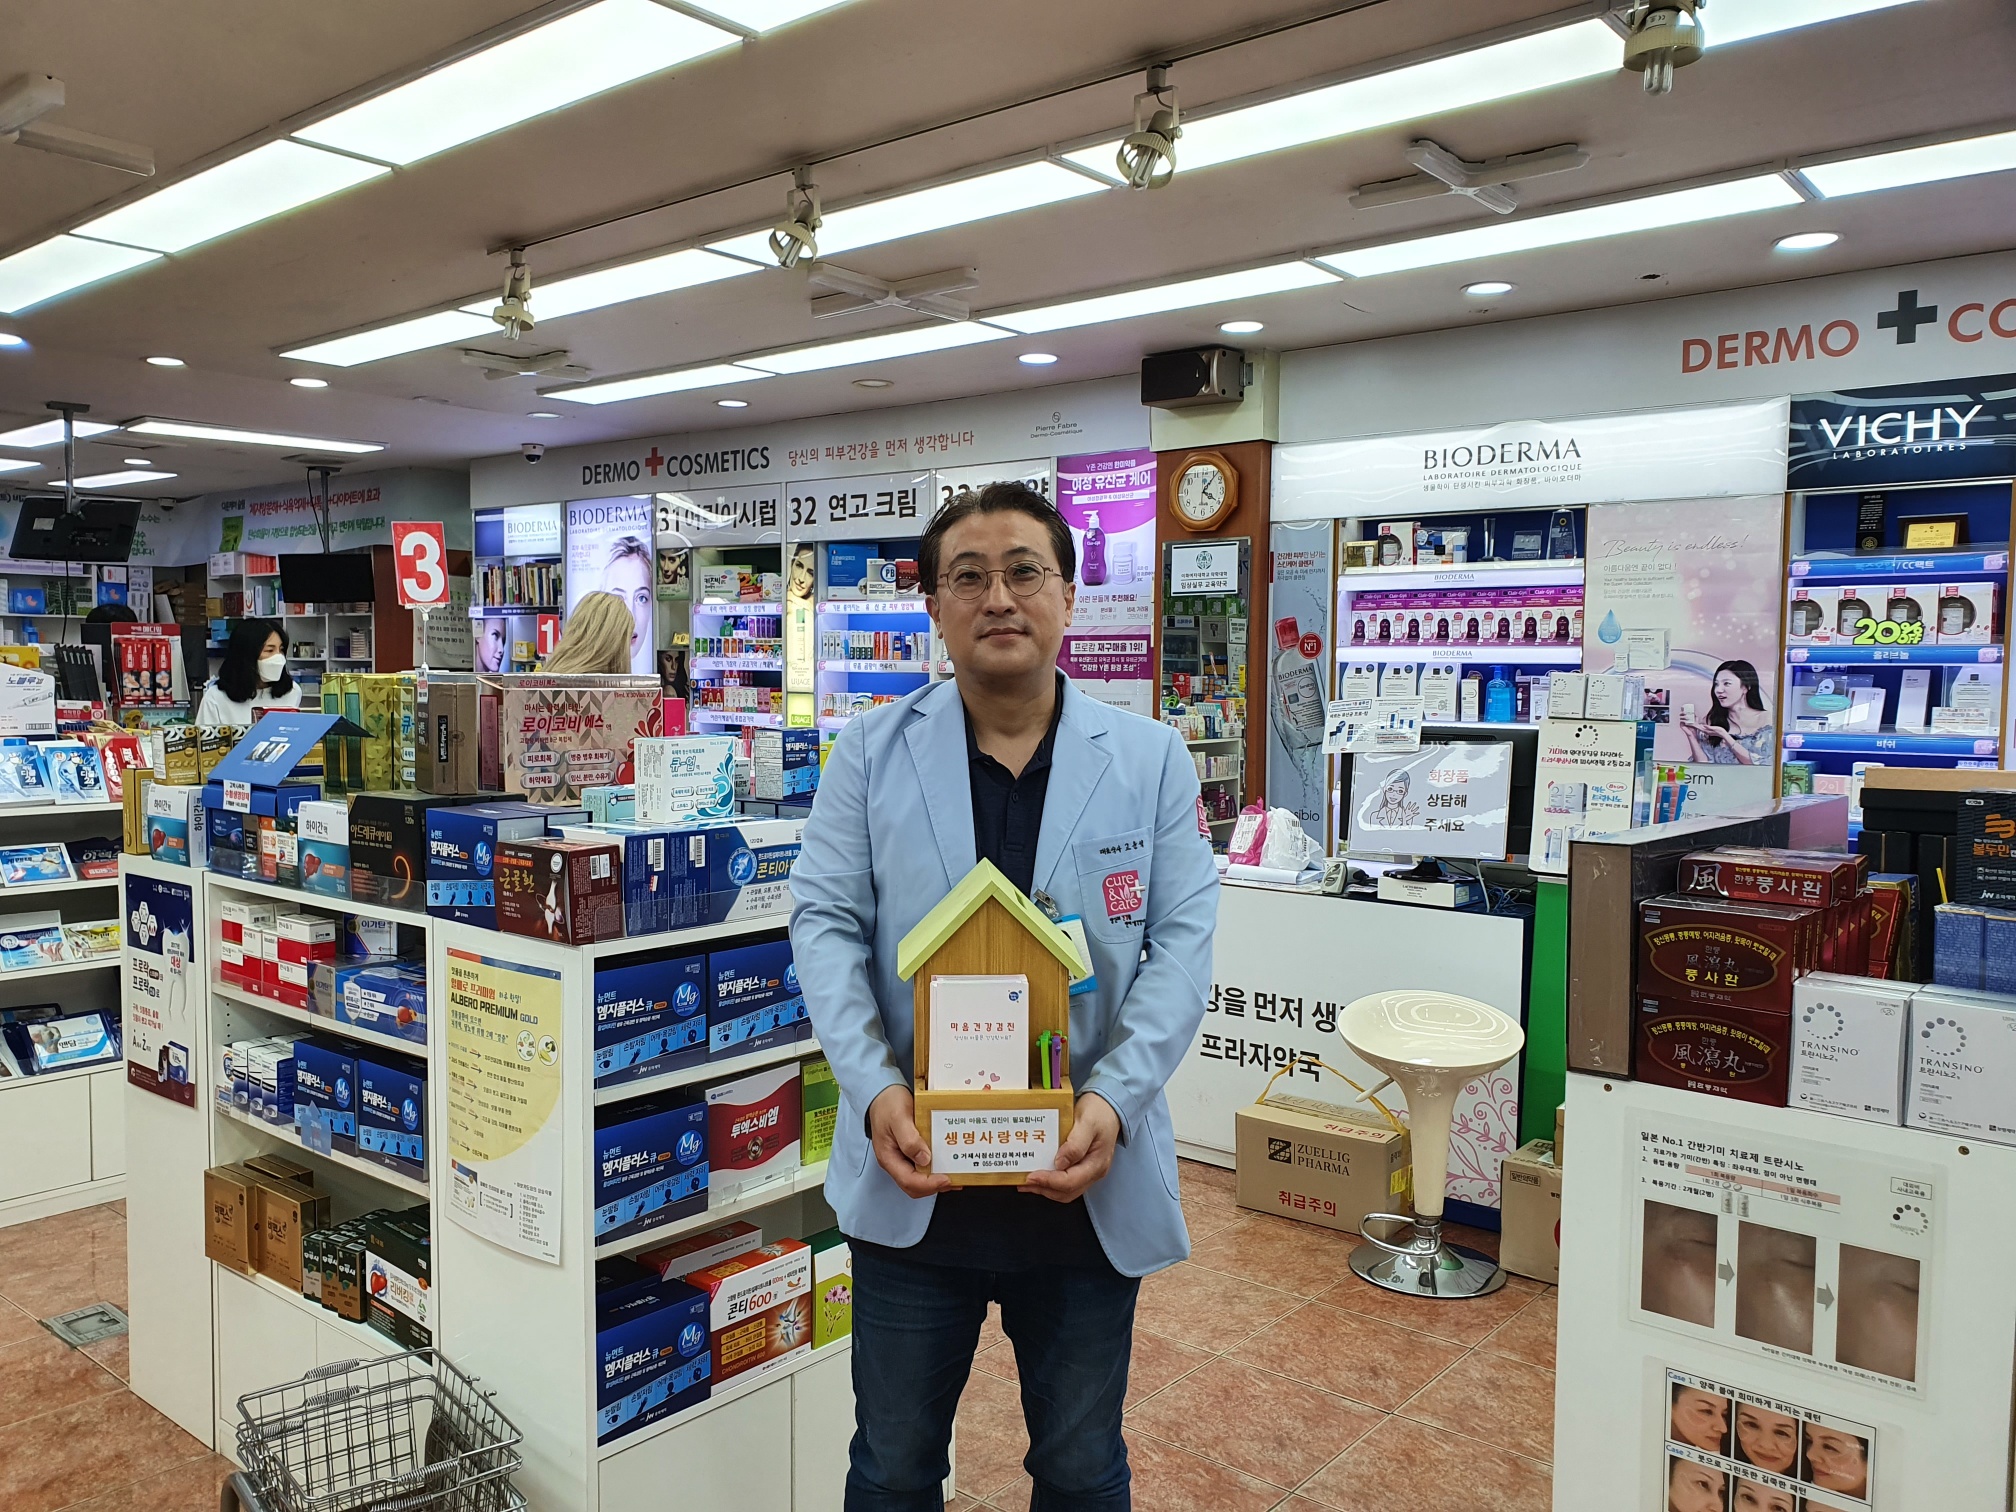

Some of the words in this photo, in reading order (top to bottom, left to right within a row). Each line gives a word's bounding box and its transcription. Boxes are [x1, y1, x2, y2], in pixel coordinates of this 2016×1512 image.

[1682, 320, 1859, 373] DERMO
[1035, 423, 1055, 432] Pierre
[1058, 421, 1077, 431] Fabre
[1820, 405, 1983, 448] VICHY
[788, 448, 819, 466] 당신의
[825, 441, 879, 461] 피부건강을
[885, 436, 908, 454] 먼저
[914, 430, 974, 453] 생각합니다
[1424, 438, 1581, 469] BIODERMA
[1833, 442, 1966, 460] LABORATOIRES
[583, 461, 640, 485] DERMO
[667, 447, 770, 477] COSMETICS
[1423, 471, 1486, 481] LABORATOIRE
[1490, 464, 1582, 476] DERMATOLOGIQUE
[1072, 477, 1091, 492] 여성
[1095, 474, 1126, 489] 유산균
[1129, 471, 1150, 485] 케어
[570, 505, 648, 526] BIODERMA
[790, 497, 817, 526] 32
[508, 520, 557, 534] BIODERMA
[400, 531, 445, 602] 3
[1434, 573, 1475, 581] BIODERMA
[541, 618, 556, 653] 1
[1897, 634, 1923, 644] OFF
[1278, 666, 1313, 681] BIODERMA
[524, 703, 545, 713] 마시는
[520, 715, 583, 734] 로이코비
[527, 754, 552, 764] 피로회복
[1429, 769, 1469, 784] 화장품
[1427, 793, 1467, 808] 상담해
[1424, 818, 1465, 833] 주세요
[477, 846, 491, 865] Mg
[1106, 874, 1135, 888] cure
[1686, 863, 1729, 897] 風
[1756, 876, 1822, 898] 풍사환
[1110, 898, 1139, 912] care
[718, 976, 759, 996] 엠지플러스
[1685, 969, 1739, 987] 풍사환
[451, 992, 478, 1010] ALBERO
[480, 1001, 518, 1020] PREMIUM
[520, 1013, 538, 1024] GOLD
[597, 999, 645, 1020] 엠지플러스
[1254, 991, 1303, 1027] 먼저
[1200, 1032, 1321, 1082] 프라자약국
[1800, 1040, 1860, 1056] TRANSINO
[1919, 1057, 1984, 1074] TRANSINO
[731, 1106, 780, 1138] 투엑스비엠
[1297, 1143, 1350, 1164] ZUELLIG
[1641, 1132, 1659, 1143] 일본
[1662, 1136, 1683, 1147] No.1
[1687, 1140, 1725, 1156] 간반기미
[1730, 1149, 1759, 1162] 치료제
[1763, 1155, 1805, 1172] 트란시노
[602, 1153, 649, 1176] 엠지플러스
[1297, 1155, 1350, 1177] PHARMA
[1278, 1190, 1336, 1218] 취급주의
[604, 1349, 651, 1378] 엠지플러스
[1668, 1371, 1686, 1383] Case
[1699, 1380, 1715, 1392] 양쪽
[1738, 1390, 1772, 1409] 희미하게
[1666, 1443, 1684, 1456] Case
